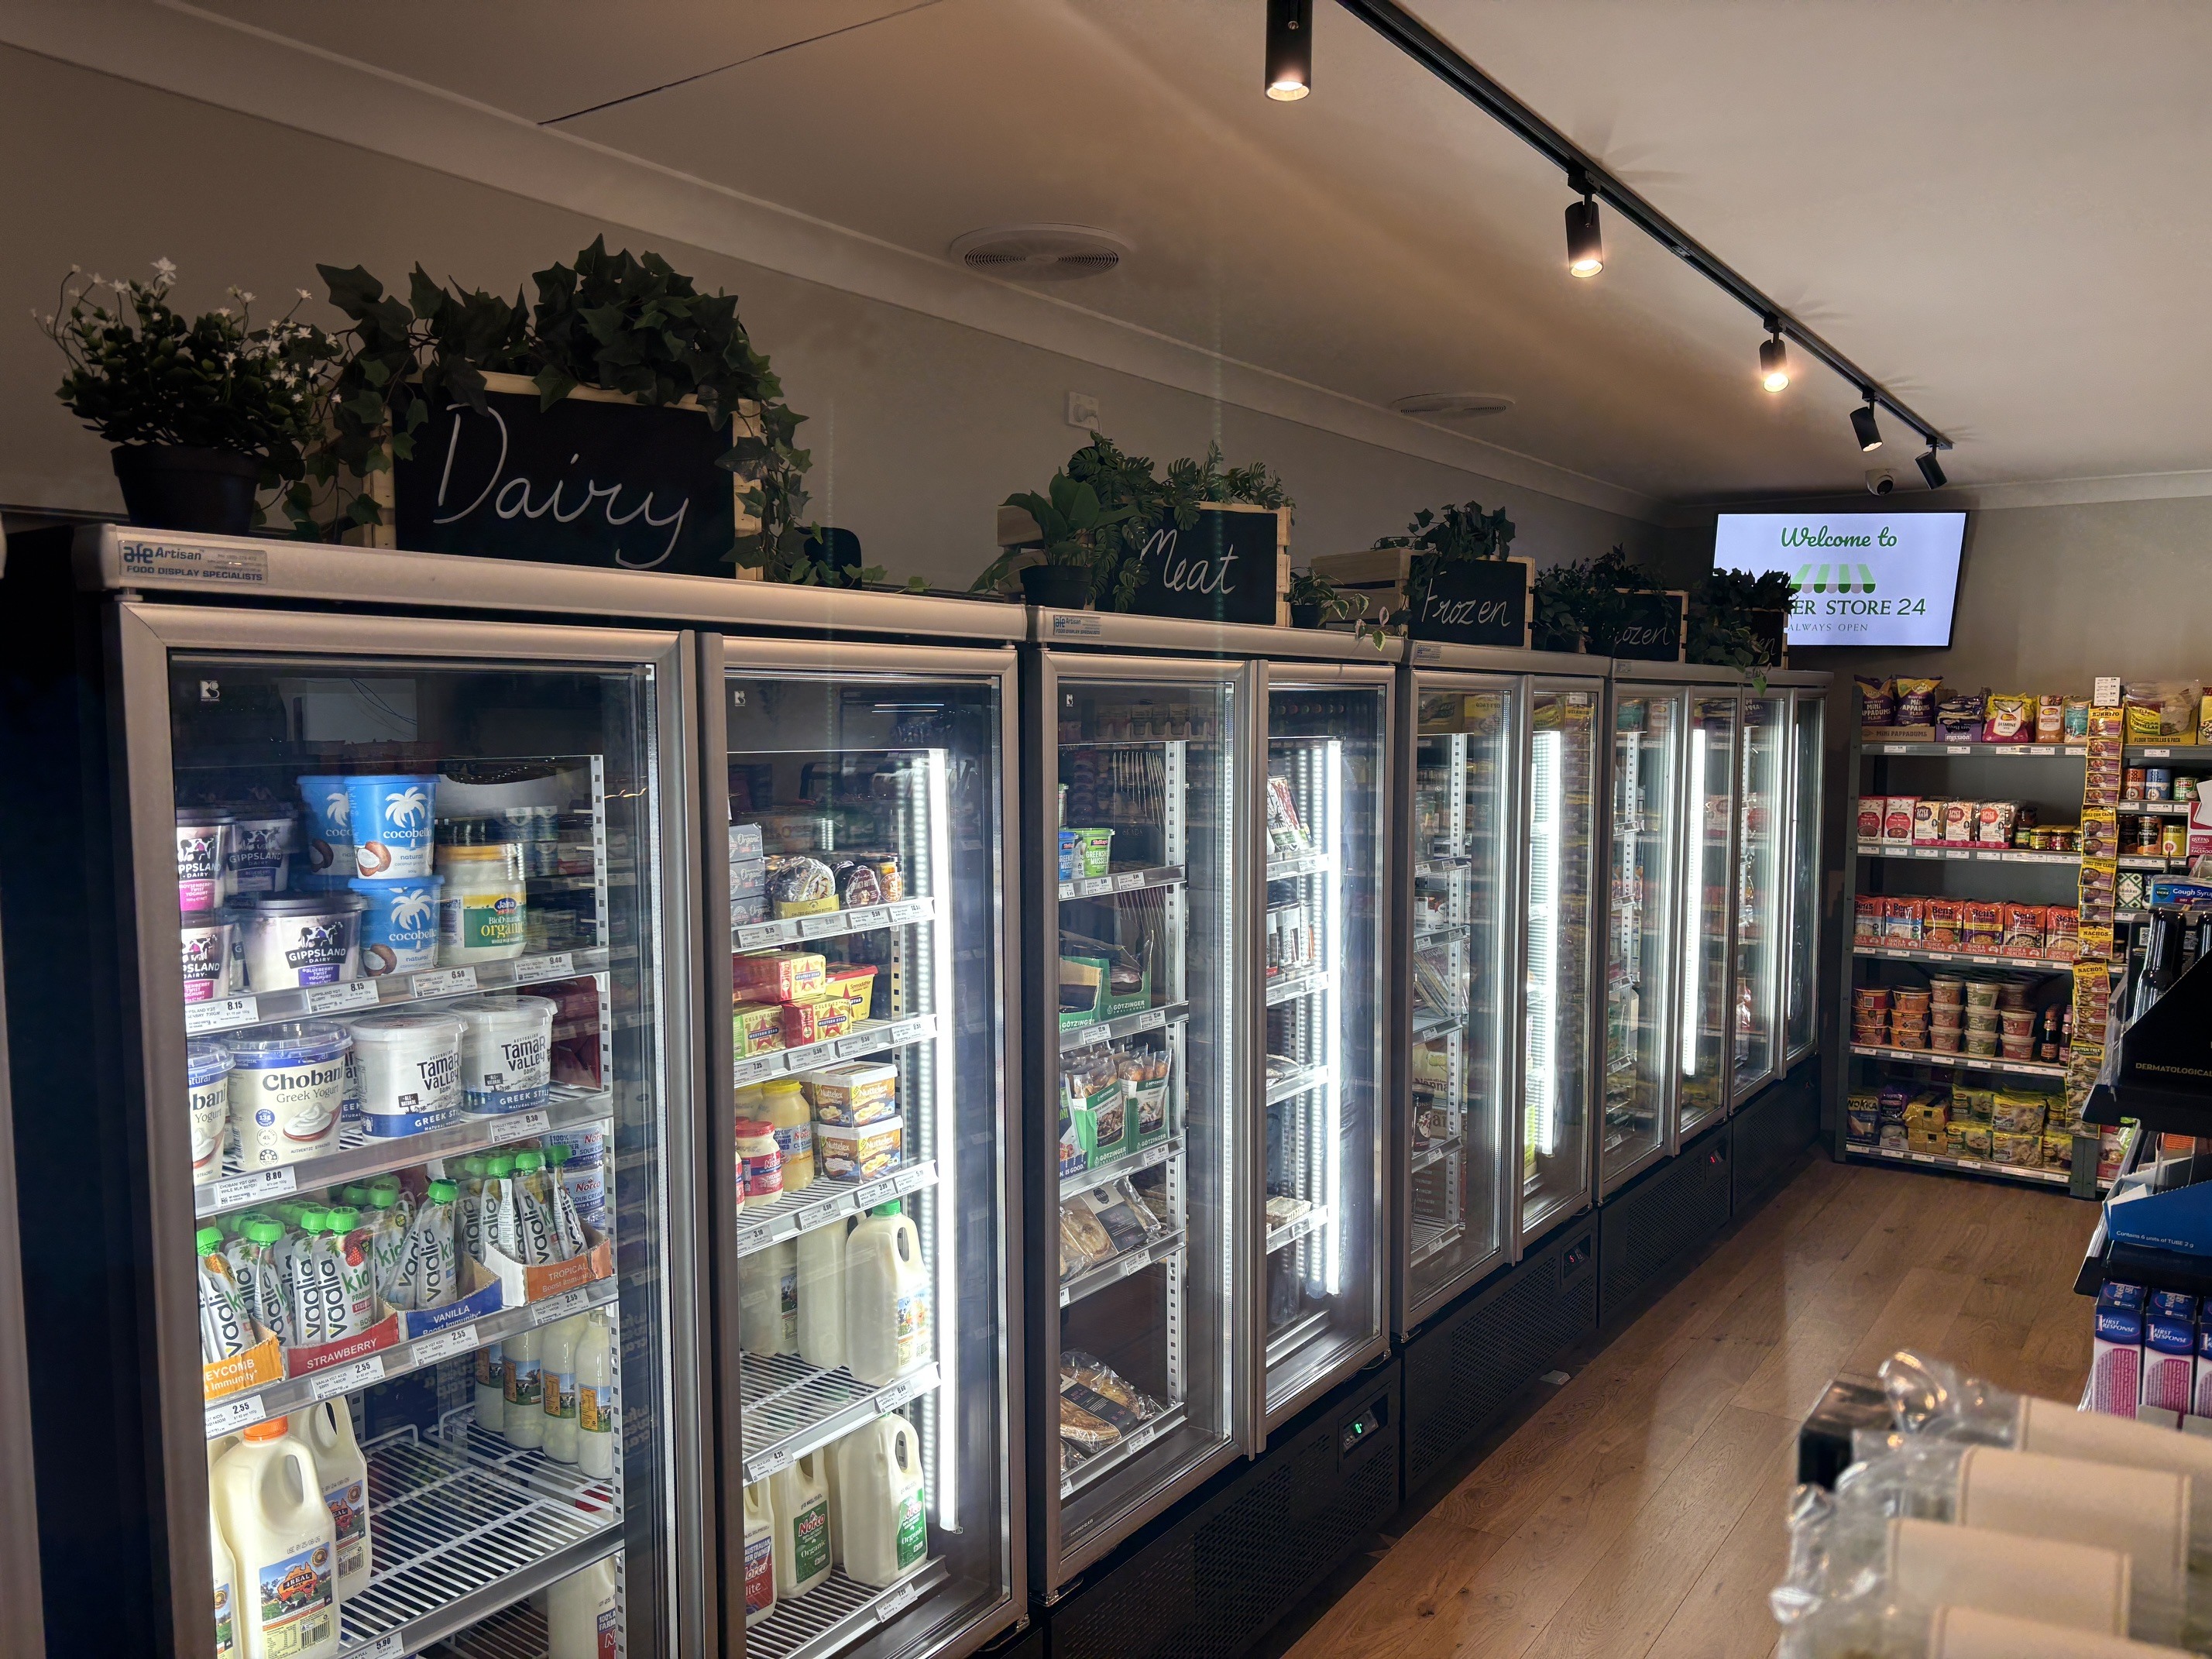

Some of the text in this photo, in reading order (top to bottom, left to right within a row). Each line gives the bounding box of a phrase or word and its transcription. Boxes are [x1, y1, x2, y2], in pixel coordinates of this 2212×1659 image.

[433, 404, 689, 568] Dairy
[1781, 525, 1898, 548] Welcome to
[155, 546, 201, 560] Artisan
[1140, 528, 1239, 595] Meat
[126, 565, 263, 581] FOOD DISPLAY SPECIALISTS
[1421, 571, 1511, 627] Frozen
[1826, 598, 1926, 615] STORE 24
[1788, 623, 1832, 632] ALWAYS
[383, 829, 432, 840] cocobella
[737, 833, 761, 845] Organic
[228, 852, 282, 864] GIPPSLAND
[740, 868, 763, 881] Organic
[2172, 888, 2196, 896] Cough
[497, 900, 514, 908] Jalna
[749, 903, 771, 915] Organic
[389, 929, 438, 942] cocobella
[480, 921, 525, 938] organic
[288, 947, 347, 962] GIPPSLAND
[452, 970, 465, 979] 6.50
[350, 982, 365, 991] 8.15
[227, 1001, 243, 1011] 8.15
[1113, 1000, 1146, 1011] GÖTZINGER
[818, 1018, 836, 1027] WESTERN
[262, 1061, 344, 1091] Chobani
[192, 1082, 226, 1111] bani
[276, 1084, 339, 1103] Greek Yogurt
[500, 1088, 549, 1106] GREEK STYLE
[820, 1090, 843, 1099] Nuttelex
[859, 1084, 888, 1097] Nuttelex
[195, 1109, 222, 1123] Yogurt
[414, 1113, 448, 1128] GREEK
[826, 1142, 850, 1152] Nuttelex
[866, 1135, 895, 1147] Nuttelex
[1141, 1134, 1166, 1147] GÖTZINGER
[1099, 1146, 1127, 1161] GÖTZINGER
[266, 1171, 282, 1181] 8.80
[575, 1180, 602, 1194] Norco
[524, 1194, 551, 1265] vaalia
[2116, 1231, 2140, 1239] Contains
[424, 1228, 442, 1303] vaalia
[548, 1264, 589, 1281] TROPICAL
[542, 1279, 563, 1293] Boost
[318, 1258, 349, 1338] vaalia
[565, 1293, 579, 1304] 2.55
[433, 1305, 471, 1324] VANILLA
[2102, 1324, 2135, 1332] RESPONSE
[451, 1331, 466, 1341] 2.55
[2153, 1333, 2186, 1343] RESPONSE
[307, 1338, 378, 1369] STRAWBERRY
[204, 1359, 255, 1381] EYCOMB
[355, 1362, 371, 1374] 2.55
[232, 1402, 250, 1414] 2.55
[798, 1513, 826, 1537] Norco
[902, 1526, 923, 1544] Organic
[801, 1540, 826, 1558] Organic
[746, 1562, 768, 1581] orco
[376, 1637, 391, 1650] 5.90
